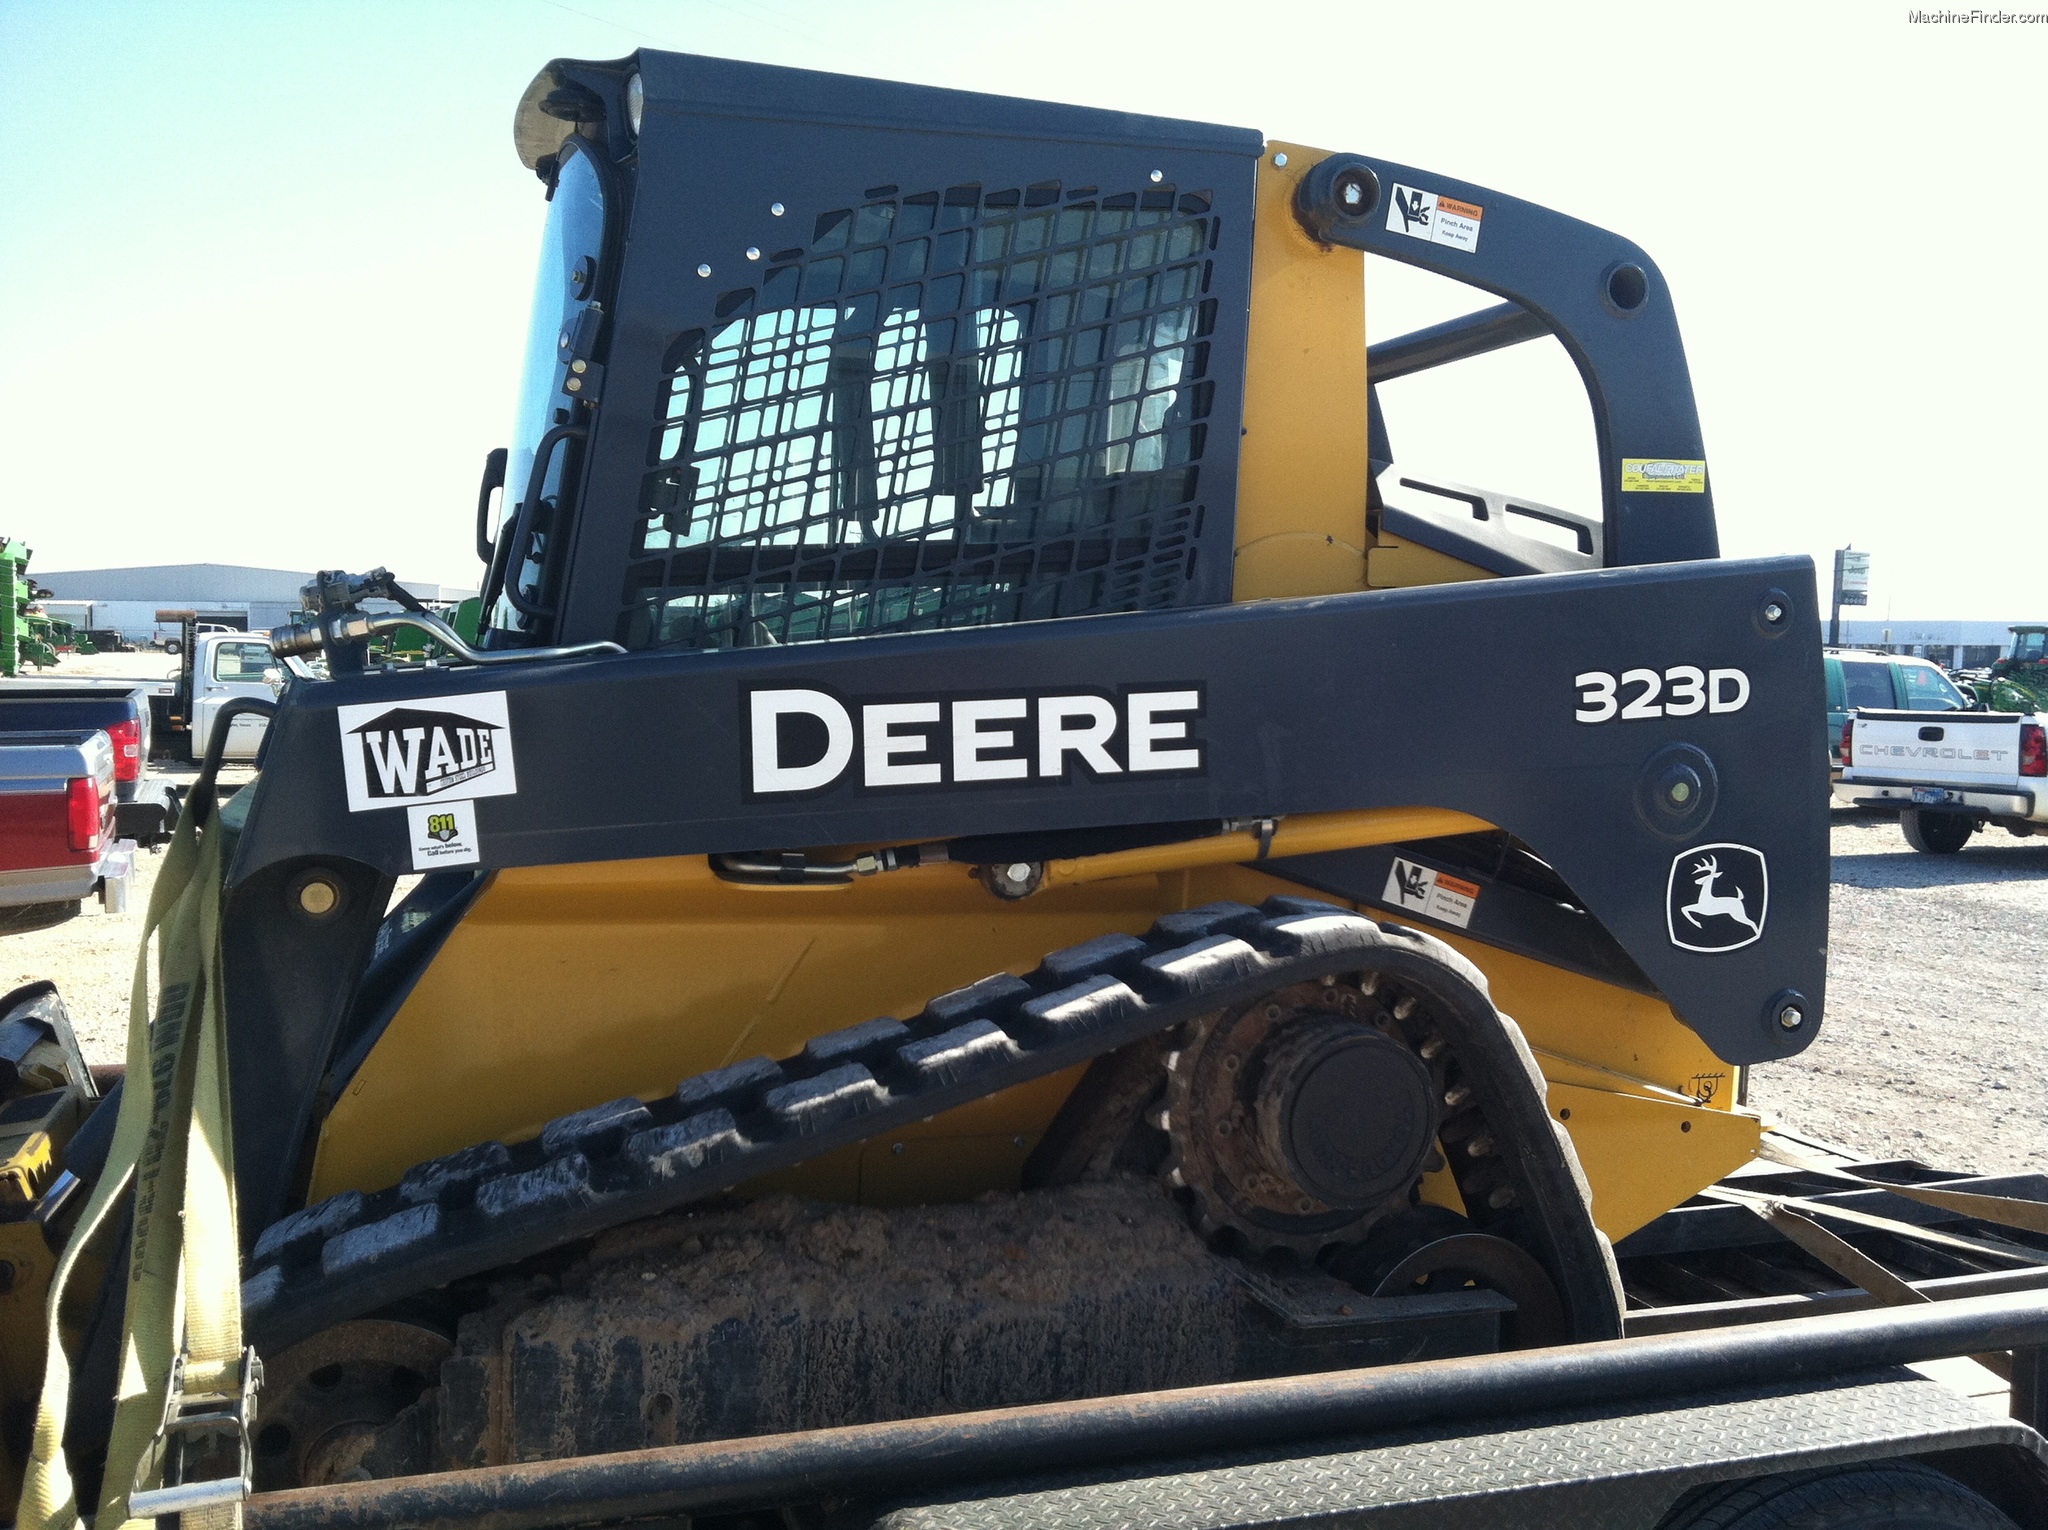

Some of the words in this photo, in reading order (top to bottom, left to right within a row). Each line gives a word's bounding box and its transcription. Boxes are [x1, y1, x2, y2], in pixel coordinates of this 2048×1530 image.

[1446, 203, 1478, 217] WARNING
[1440, 217, 1458, 228] Pinch
[1459, 222, 1474, 232] Area
[1455, 234, 1469, 243] Away
[1575, 665, 1750, 723] 323D
[750, 688, 1200, 793] DEERE
[365, 726, 492, 794] WADE
[1859, 744, 2008, 761] CHEVROLET
[428, 814, 454, 833] 811
